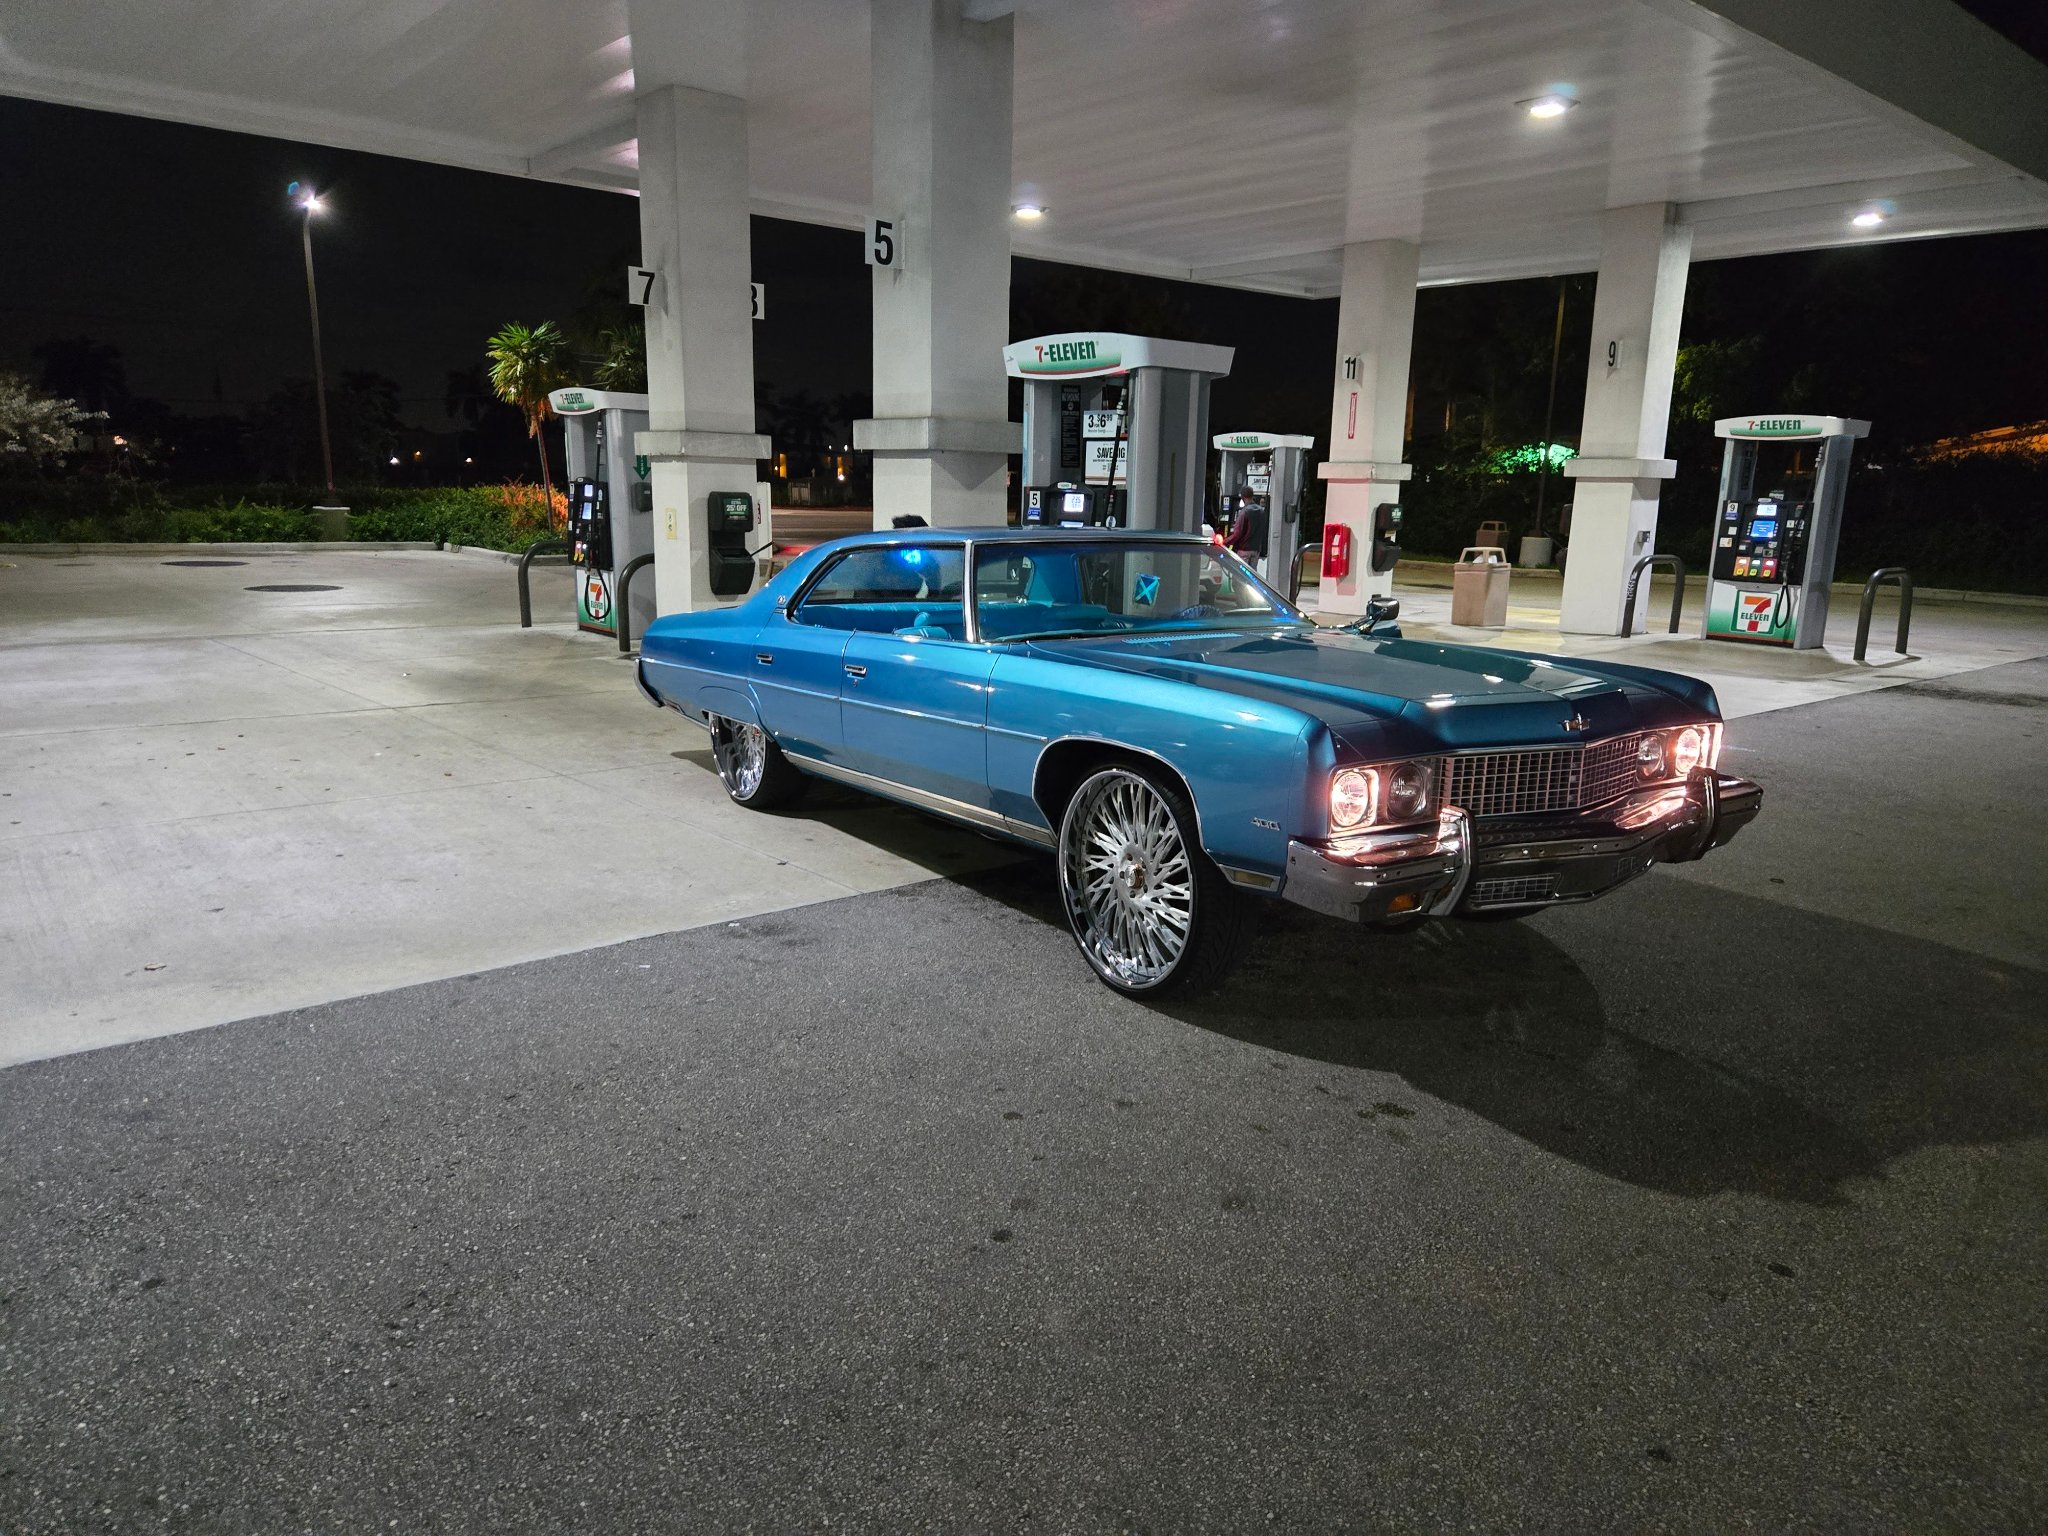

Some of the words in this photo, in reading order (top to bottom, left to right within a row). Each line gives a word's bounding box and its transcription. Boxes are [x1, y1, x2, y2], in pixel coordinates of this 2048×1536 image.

[875, 220, 893, 265] 5
[638, 271, 655, 304] 7
[1608, 341, 1616, 367] 9
[1345, 357, 1356, 379] 11
[1088, 415, 1094, 428] 3
[1097, 447, 1113, 459] SAVE
[1032, 493, 1037, 505] 5
[1744, 596, 1771, 631] 7
[1251, 817, 1280, 831] 400
